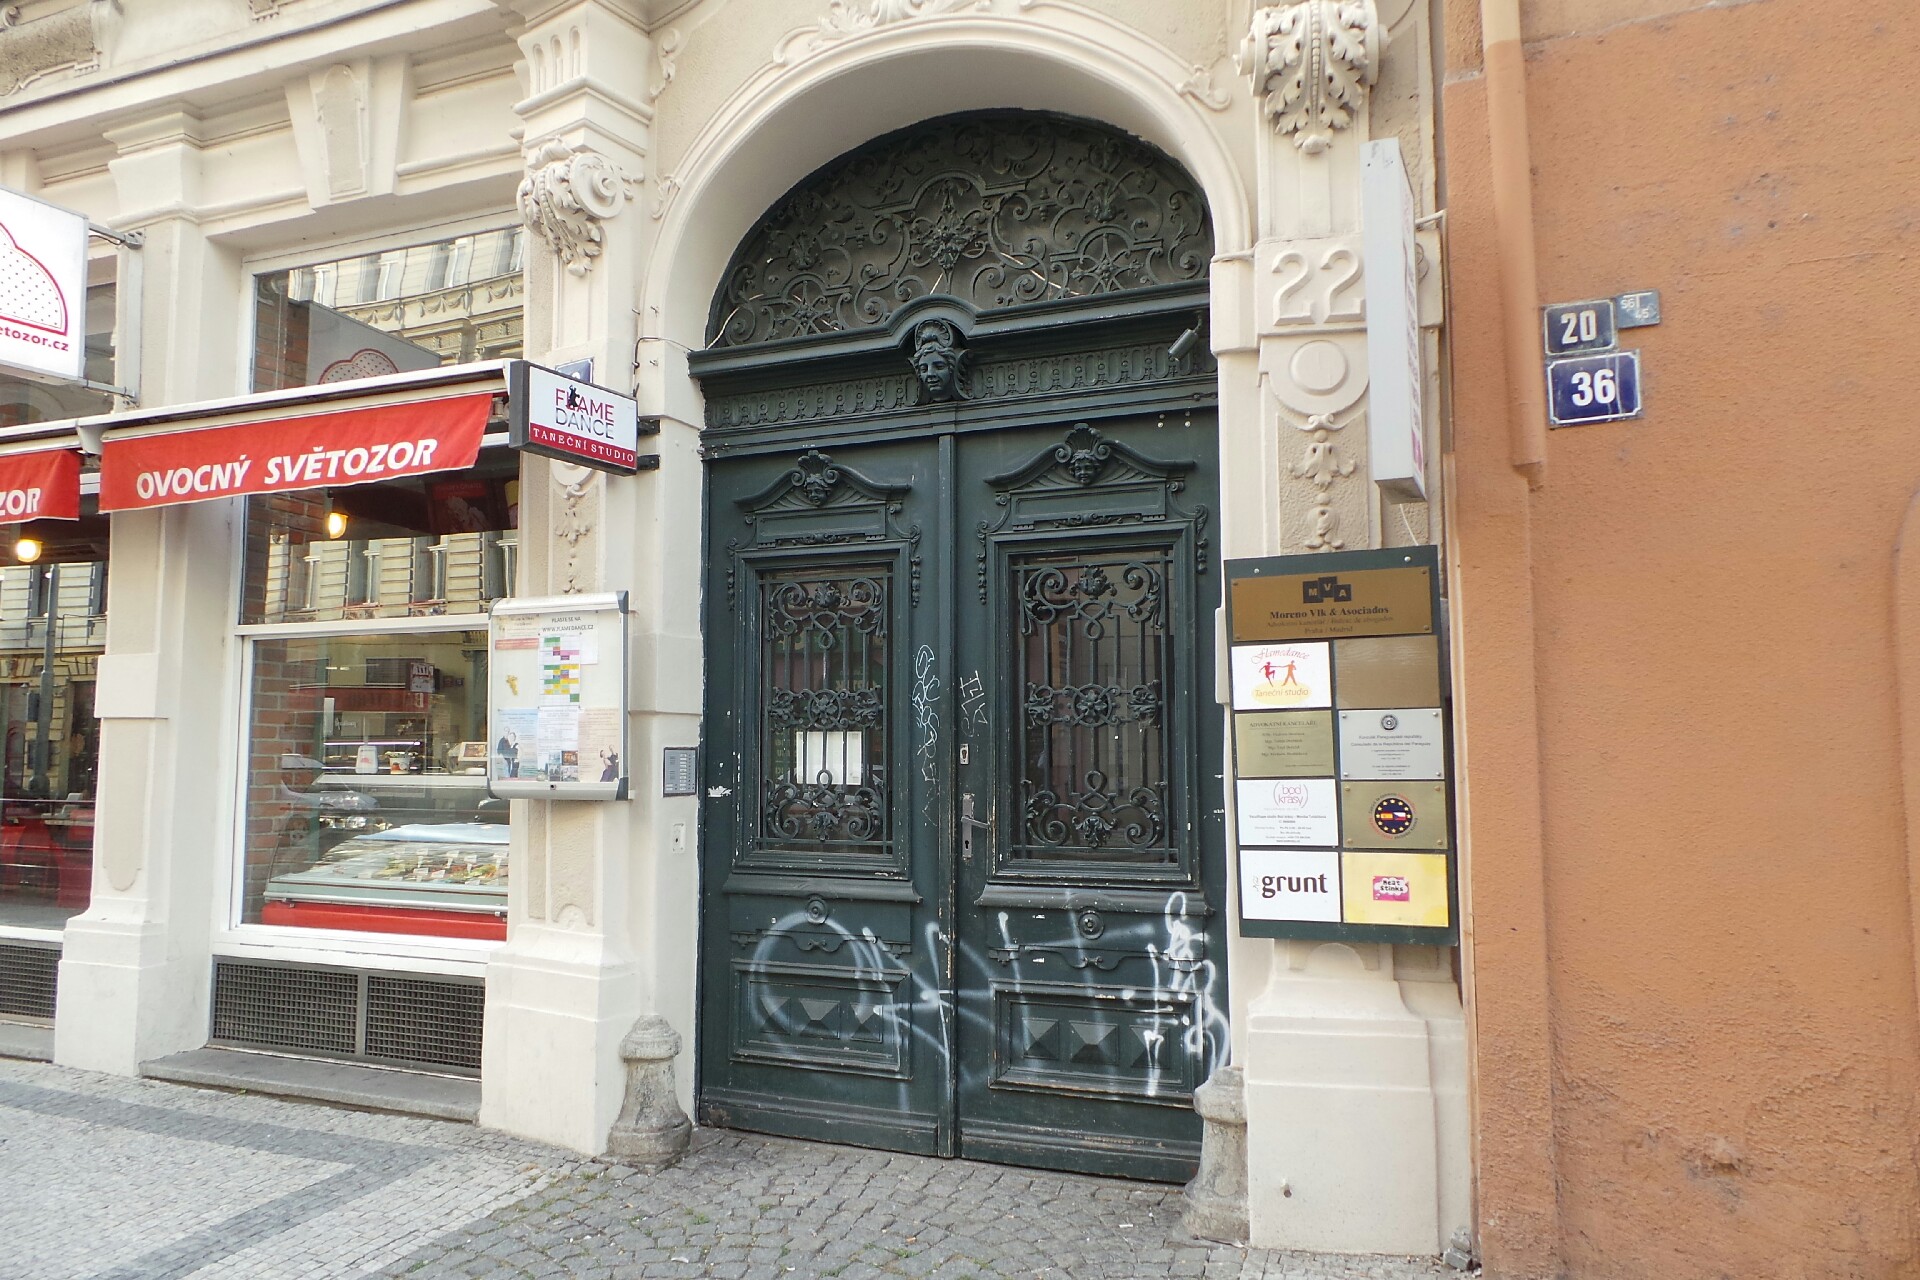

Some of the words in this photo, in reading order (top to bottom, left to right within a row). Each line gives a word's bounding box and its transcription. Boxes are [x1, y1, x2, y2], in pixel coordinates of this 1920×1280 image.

[1560, 310, 1598, 345] 20
[555, 387, 615, 423] FLAME
[1571, 368, 1616, 407] 36
[555, 407, 615, 440] DANCE
[533, 427, 587, 451] TANEČNÍ
[590, 444, 634, 462] STUDIO
[136, 454, 252, 499] OVOCNÝ
[264, 438, 438, 485] SVĚTOZOR
[1269, 611, 1307, 620] Moreno
[1310, 608, 1327, 617] Vlk
[1329, 607, 1337, 616] &
[1339, 605, 1389, 615] Asociados
[1261, 873, 1329, 898] grunt
